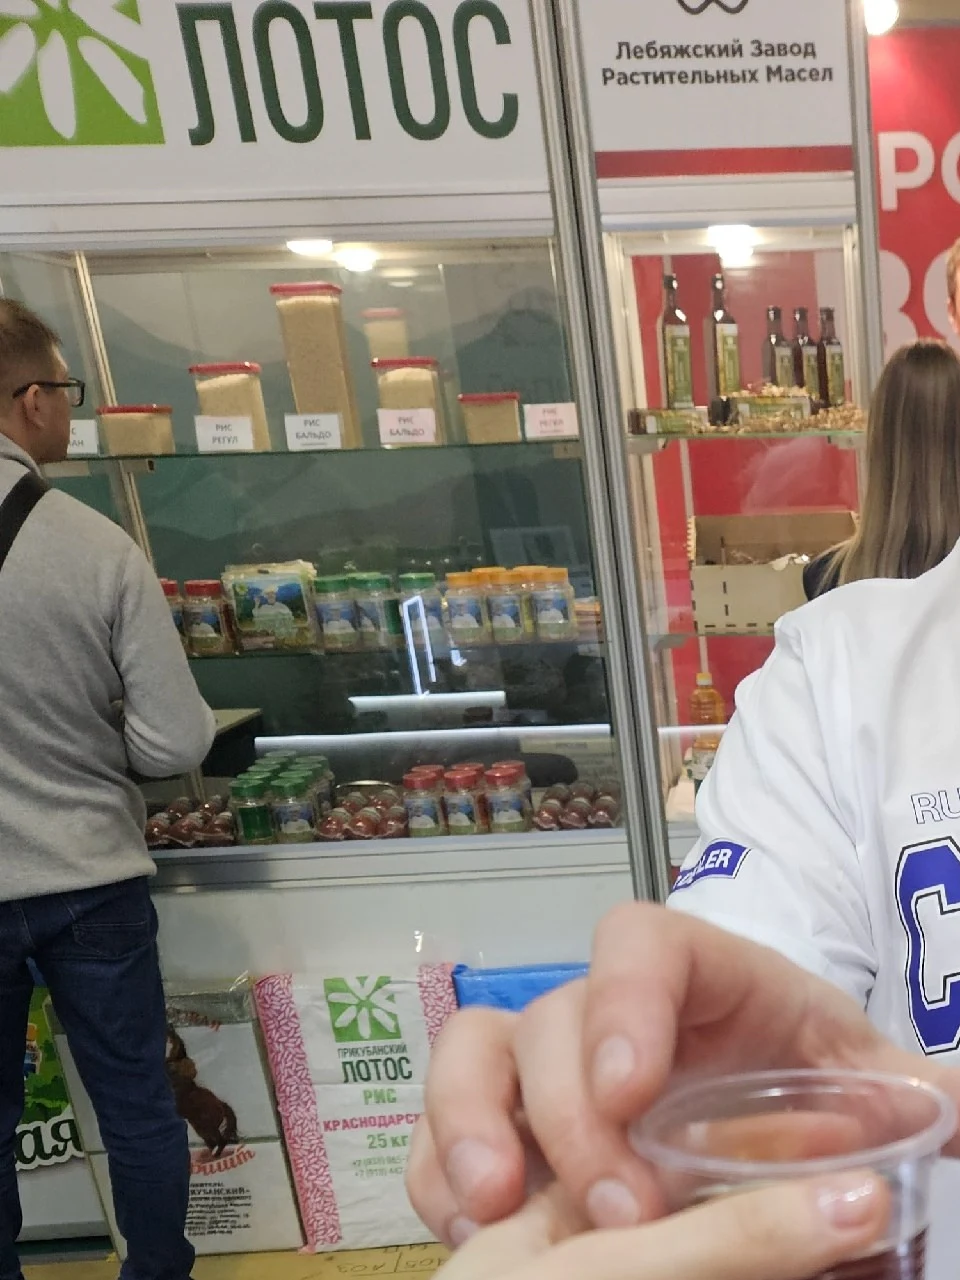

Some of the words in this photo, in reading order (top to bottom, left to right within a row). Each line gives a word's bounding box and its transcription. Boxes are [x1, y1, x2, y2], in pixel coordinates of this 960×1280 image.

[615, 39, 743, 61] Лебяжский
[750, 40, 816, 60] Завод
[177, 0, 518, 146] ЛОТОС
[601, 67, 759, 87] Растительных
[765, 65, 833, 84] Масел
[215, 423, 233, 432] РИС
[303, 419, 321, 428] РИС
[295, 430, 332, 440] БАЛЬДО
[337, 1043, 408, 1059] ПРИКУБАНСКИЙ
[341, 1056, 413, 1084] ЛОТОС
[363, 1088, 398, 1105] РИС
[367, 1133, 387, 1149] 25
